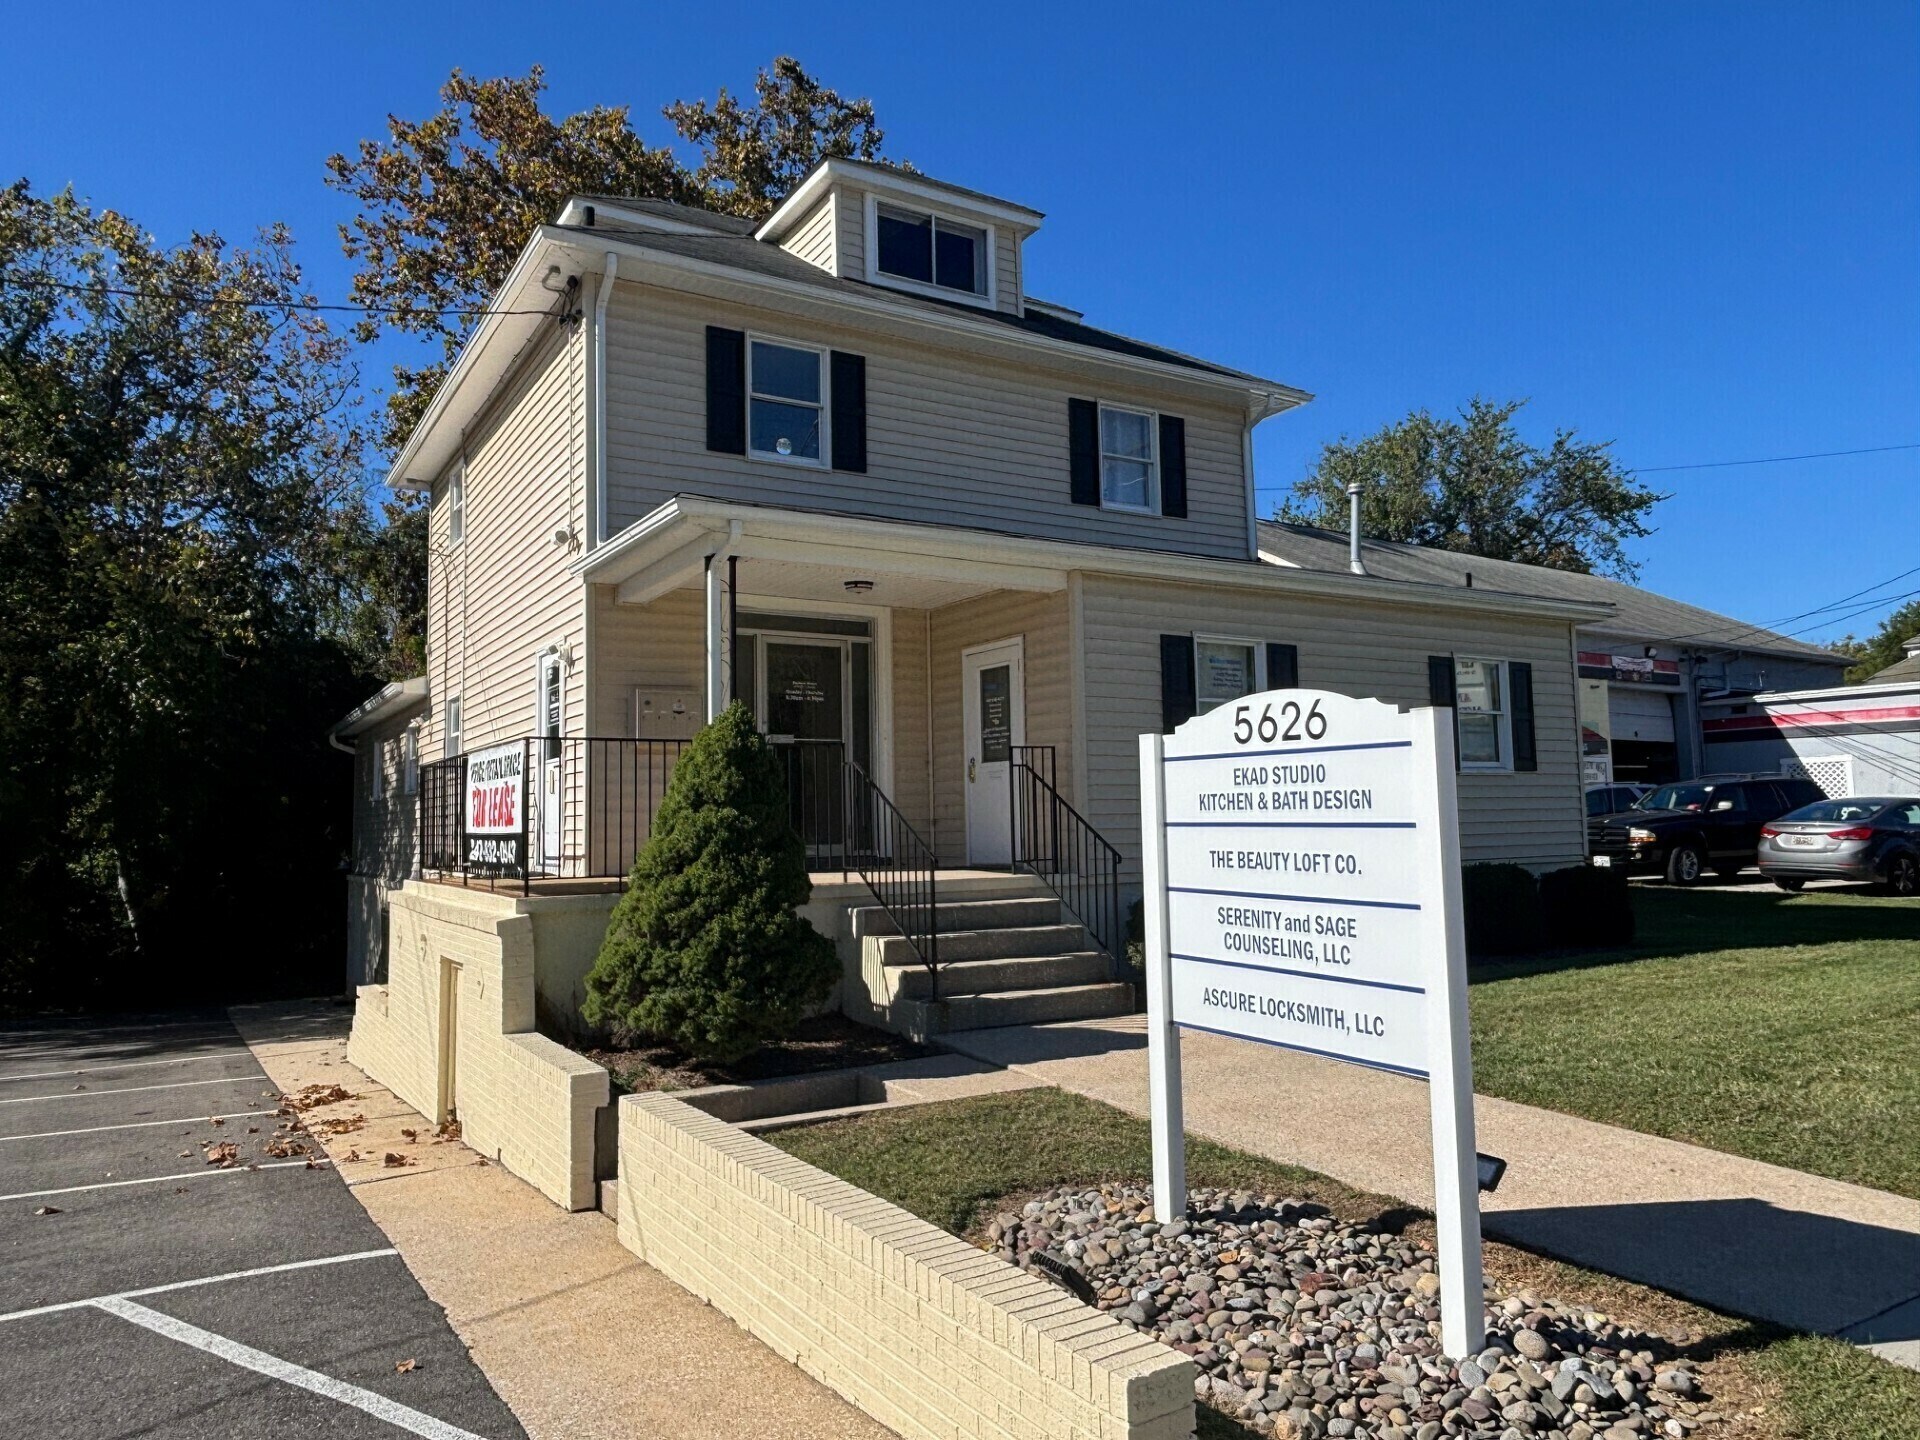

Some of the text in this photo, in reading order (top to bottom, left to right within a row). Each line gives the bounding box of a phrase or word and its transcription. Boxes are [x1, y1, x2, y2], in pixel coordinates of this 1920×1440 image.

[1234, 698, 1327, 744] 5626
[1233, 764, 1326, 786] EKAD STUDIO
[472, 784, 515, 827] FOR LEASE
[1199, 789, 1372, 811] KITCHEN & BATH DESIGN
[1209, 850, 1362, 875] THE BEAUTY LOFT CO.
[1217, 906, 1357, 939] SERENITY and SAGE
[1224, 931, 1351, 966] COUNSELING, LLC
[1203, 987, 1385, 1037] ASCURE LOCKSMITH, LLC
